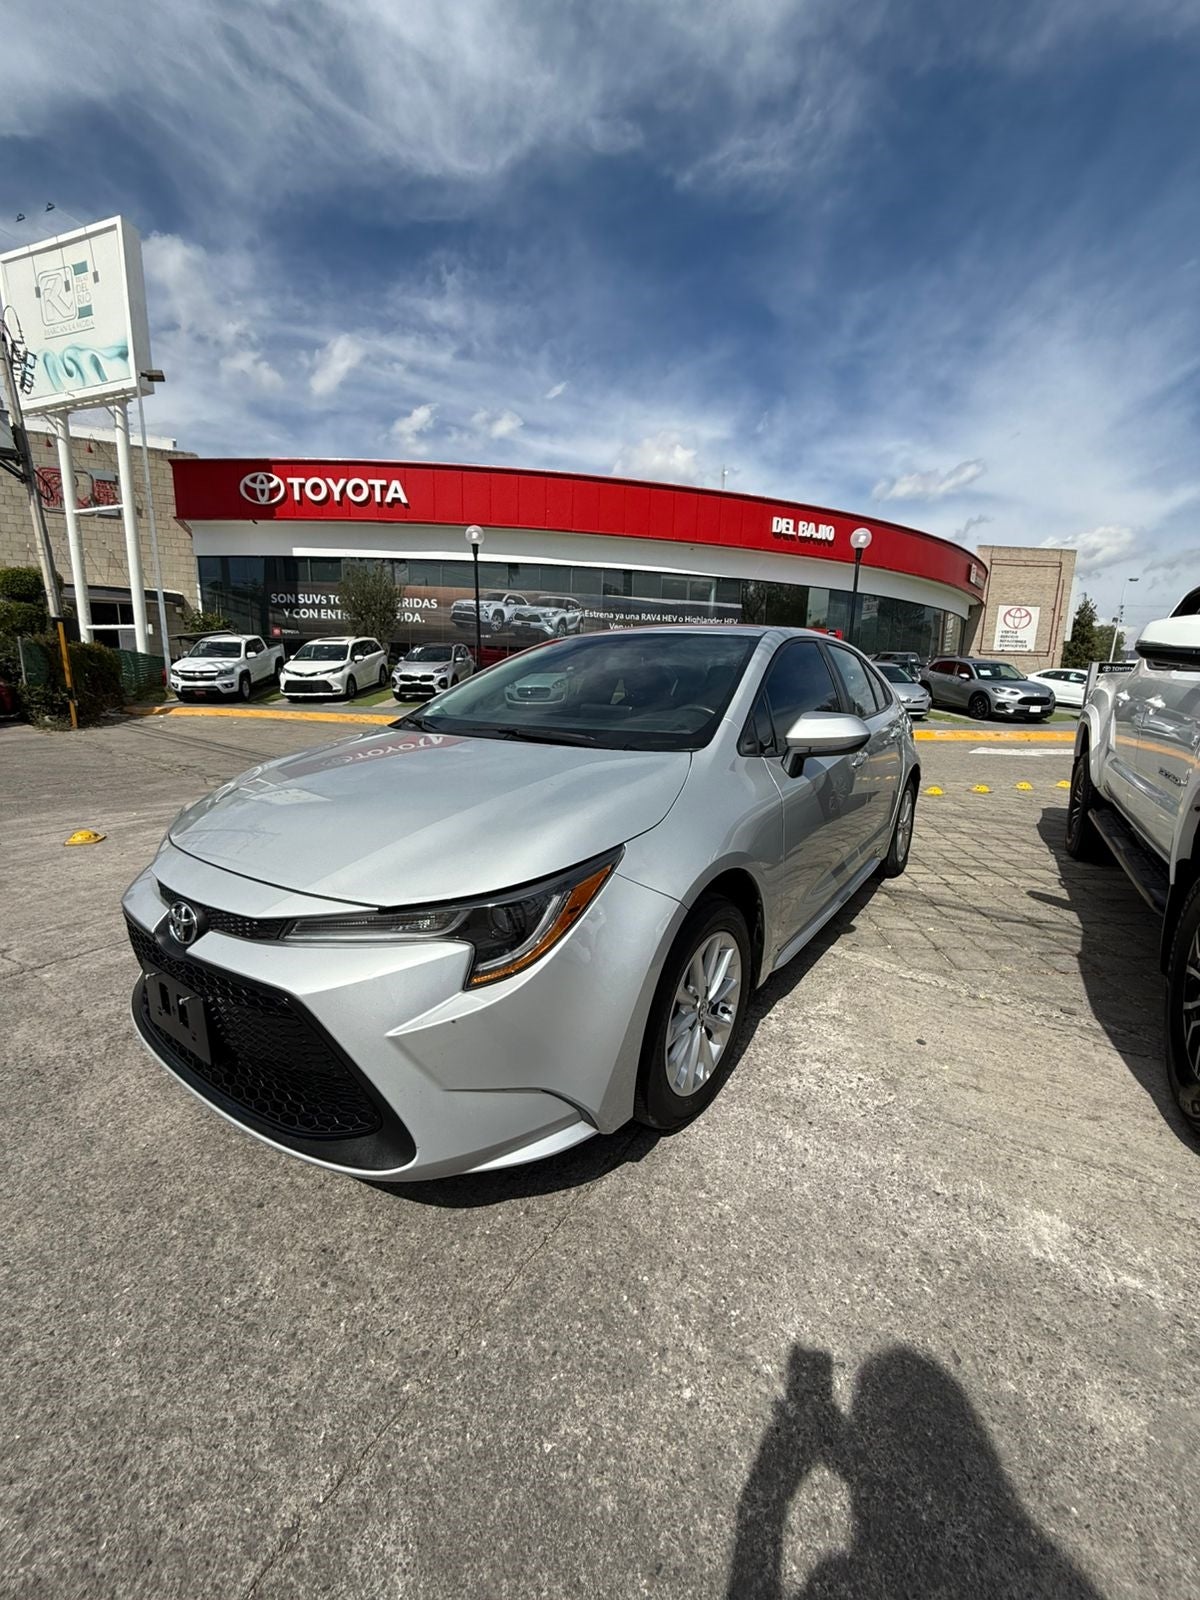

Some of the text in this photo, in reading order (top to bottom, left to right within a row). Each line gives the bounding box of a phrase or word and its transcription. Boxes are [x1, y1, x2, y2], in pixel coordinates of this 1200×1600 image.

[76, 282, 89, 294] DEL
[287, 477, 408, 503] TOYOTA
[772, 516, 835, 541] DEL BAJIO
[271, 593, 295, 604] SON
[297, 593, 327, 605] SUVs
[283, 608, 290, 618] Y
[292, 608, 318, 619] CON
[584, 609, 614, 619] Estrena
[615, 613, 624, 621] ya
[641, 613, 661, 622] RAV4
[661, 614, 678, 623] HEV
[684, 615, 723, 624] Highlander
[723, 617, 739, 625] HEV
